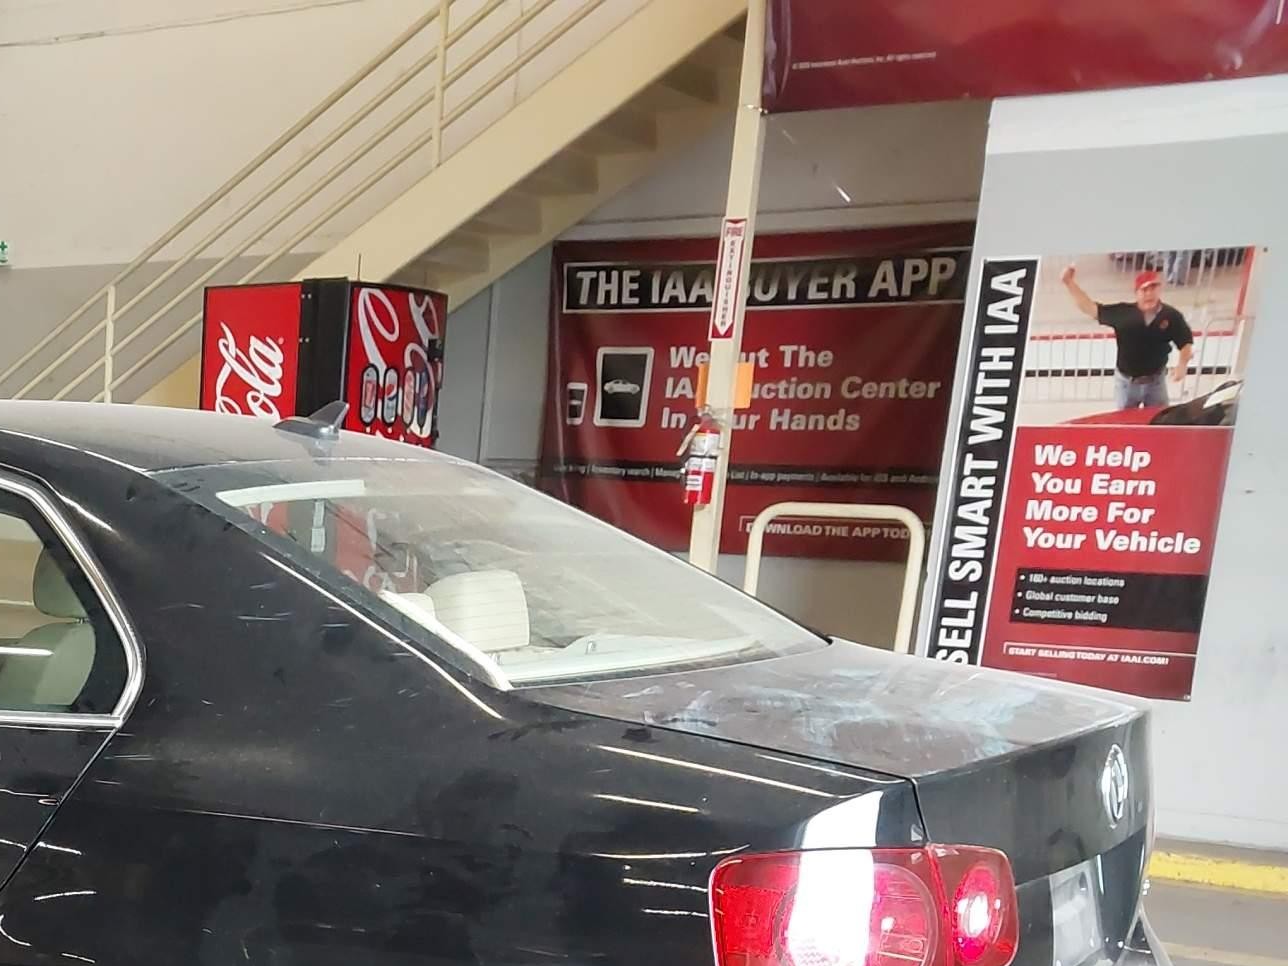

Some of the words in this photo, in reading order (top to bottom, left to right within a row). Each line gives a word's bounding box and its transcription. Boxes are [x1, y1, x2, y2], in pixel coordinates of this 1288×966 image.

[576, 268, 641, 306] THE
[651, 268, 713, 305] IAA
[745, 260, 859, 302] UYER
[867, 255, 957, 298] APP
[984, 268, 1027, 335] IAA
[669, 345, 710, 368] We
[779, 345, 834, 368] The
[665, 376, 695, 399] IA
[752, 377, 831, 399] uction
[840, 375, 941, 399] Center
[967, 347, 1016, 445] WITH
[661, 407, 687, 429] In
[769, 409, 861, 432] Hands
[1034, 444, 1077, 467] We
[1085, 445, 1152, 473] Help
[1031, 471, 1082, 494] You
[1090, 473, 1156, 496] Earn
[948, 453, 999, 582] SMART
[1025, 499, 1099, 522] More
[1107, 501, 1155, 524] For
[746, 522, 822, 536] DWNLOAD
[824, 525, 849, 537] THE
[852, 527, 880, 538] APP
[1022, 526, 1087, 549] Your
[1095, 528, 1201, 554] Vehicle
[1049, 574, 1083, 585] auction
[1083, 576, 1125, 588] locations
[1025, 590, 1054, 601] Global
[1054, 593, 1096, 604] customer
[1097, 595, 1120, 605] base
[936, 591, 979, 664] SELL
[1022, 607, 1073, 620] Competitive
[1074, 610, 1108, 623] bidding
[1037, 649, 1075, 660] SELLING
[1107, 654, 1121, 662] AT
